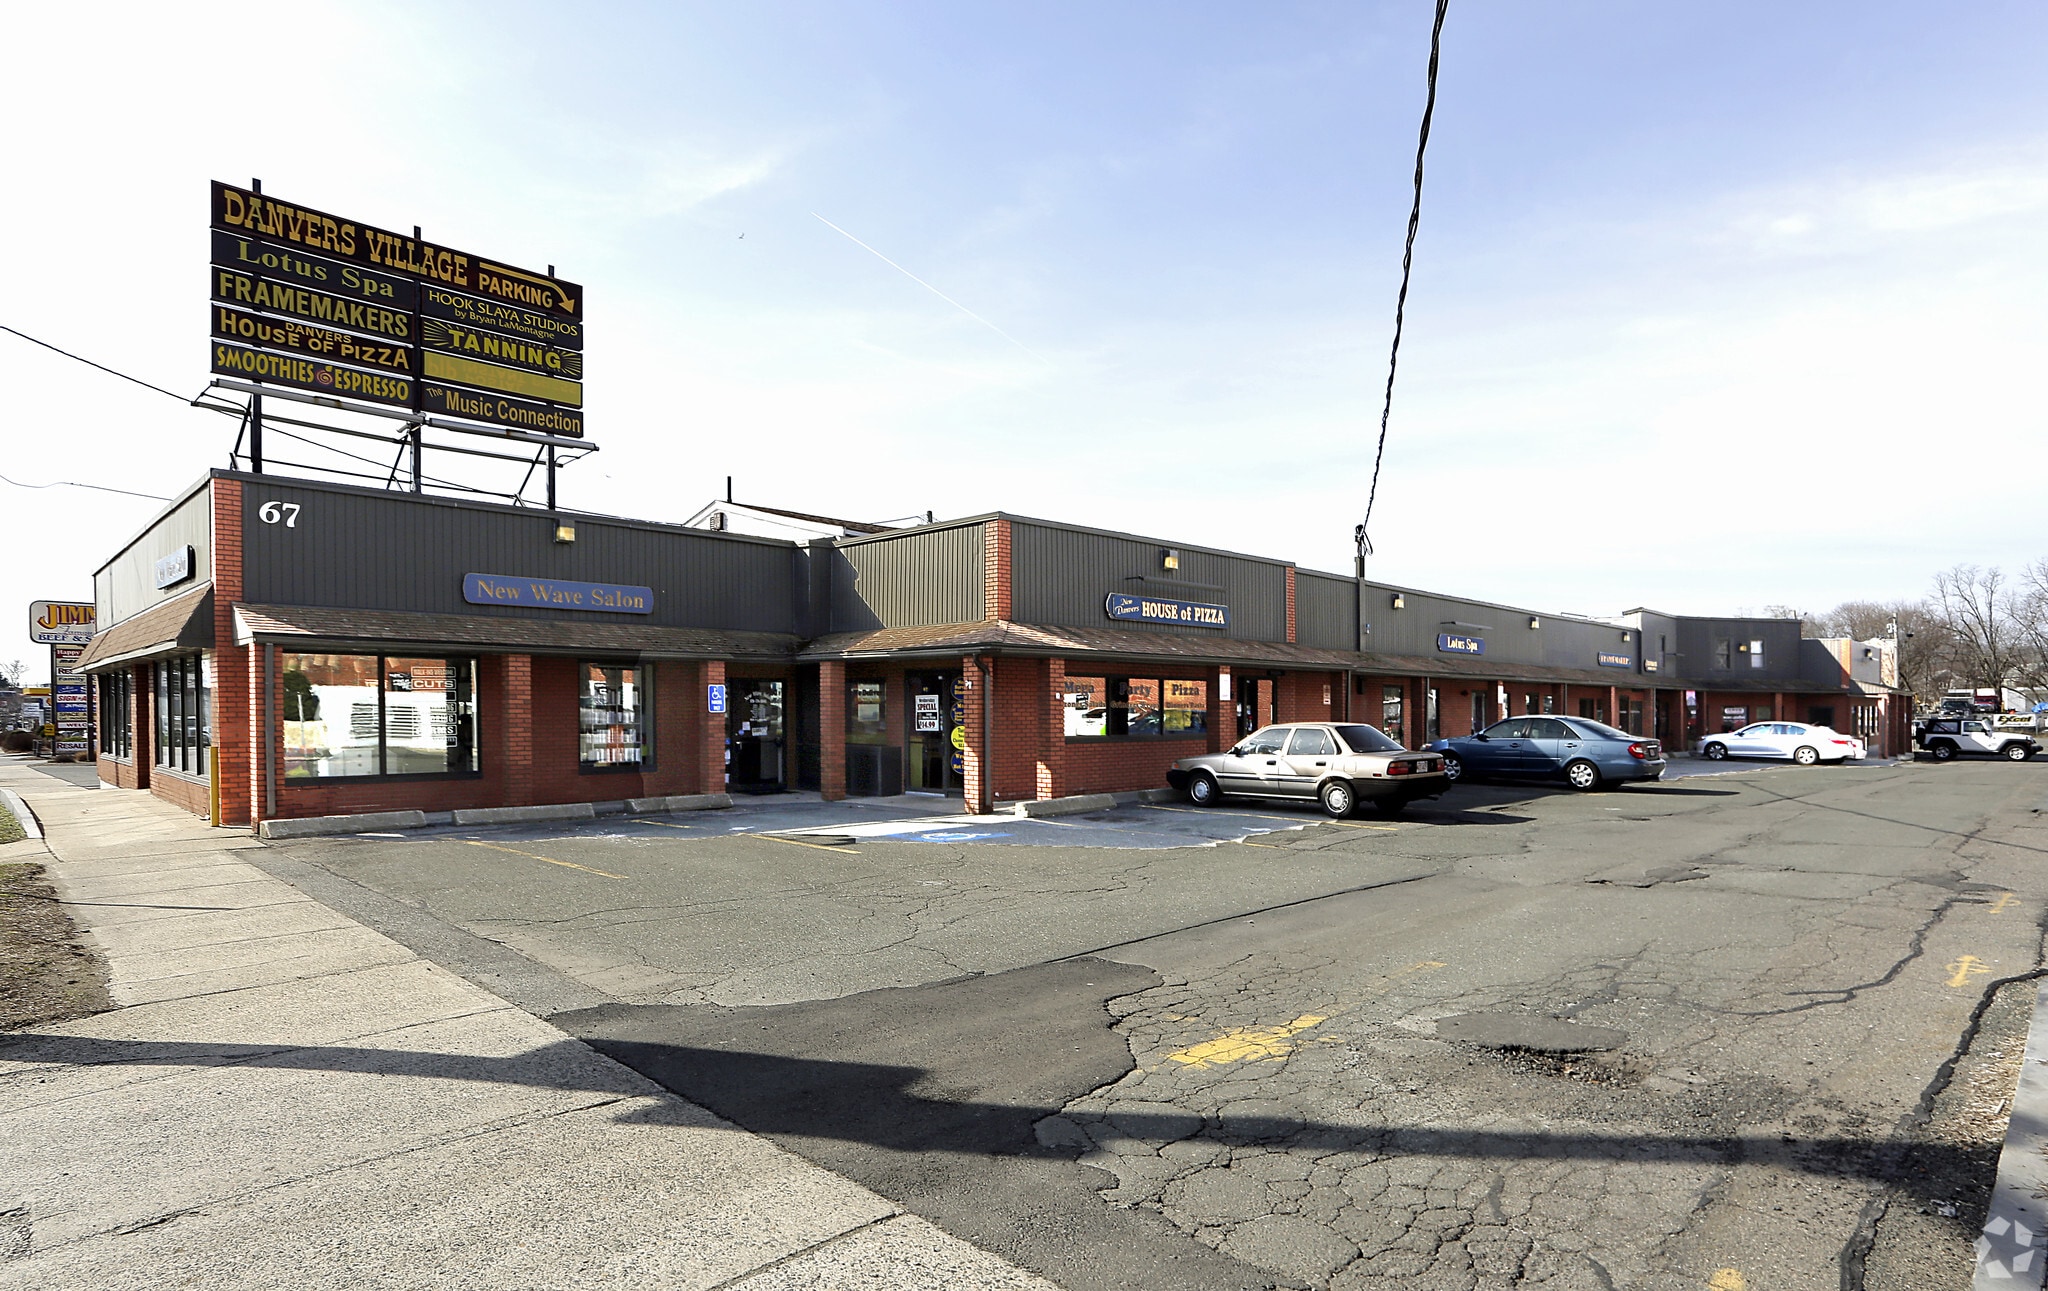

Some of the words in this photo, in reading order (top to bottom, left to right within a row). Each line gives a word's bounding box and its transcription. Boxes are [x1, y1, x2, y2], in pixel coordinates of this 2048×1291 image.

[224, 189, 356, 256] DANVERS
[365, 229, 468, 286] VILLAGE
[237, 240, 328, 281] Lotus
[341, 267, 395, 297] Spa
[219, 272, 409, 337] FRAMEMAKERS
[479, 273, 553, 308] PARKING
[429, 290, 473, 310] HOOK
[478, 302, 520, 322] SLAYA
[523, 313, 578, 337] STUDIOS
[454, 309, 467, 319] by
[470, 312, 496, 325] Bryan
[499, 318, 555, 339] LaMontagne
[220, 308, 300, 347] HOUSE
[308, 338, 334, 353] OF
[341, 344, 410, 370] PIZZA
[285, 322, 352, 344] DANVERS
[448, 329, 561, 370] TANNING
[217, 345, 315, 383] SMOOTHIES
[334, 368, 409, 401] ESPRESSO
[425, 387, 443, 398] The
[446, 390, 493, 417] Music
[497, 400, 581, 433] Connection
[259, 501, 300, 528] 67
[477, 579, 520, 599] New
[530, 583, 583, 604] Wave
[591, 588, 644, 609] Salon
[1141, 601, 1178, 620] HOUSE
[1181, 606, 1192, 621] of
[1194, 607, 1225, 624] PIZZA
[413, 680, 454, 688] CUTS
[1064, 681, 1095, 696] Mega
[1119, 681, 1152, 697] Party
[1171, 683, 1200, 696] Pizza
